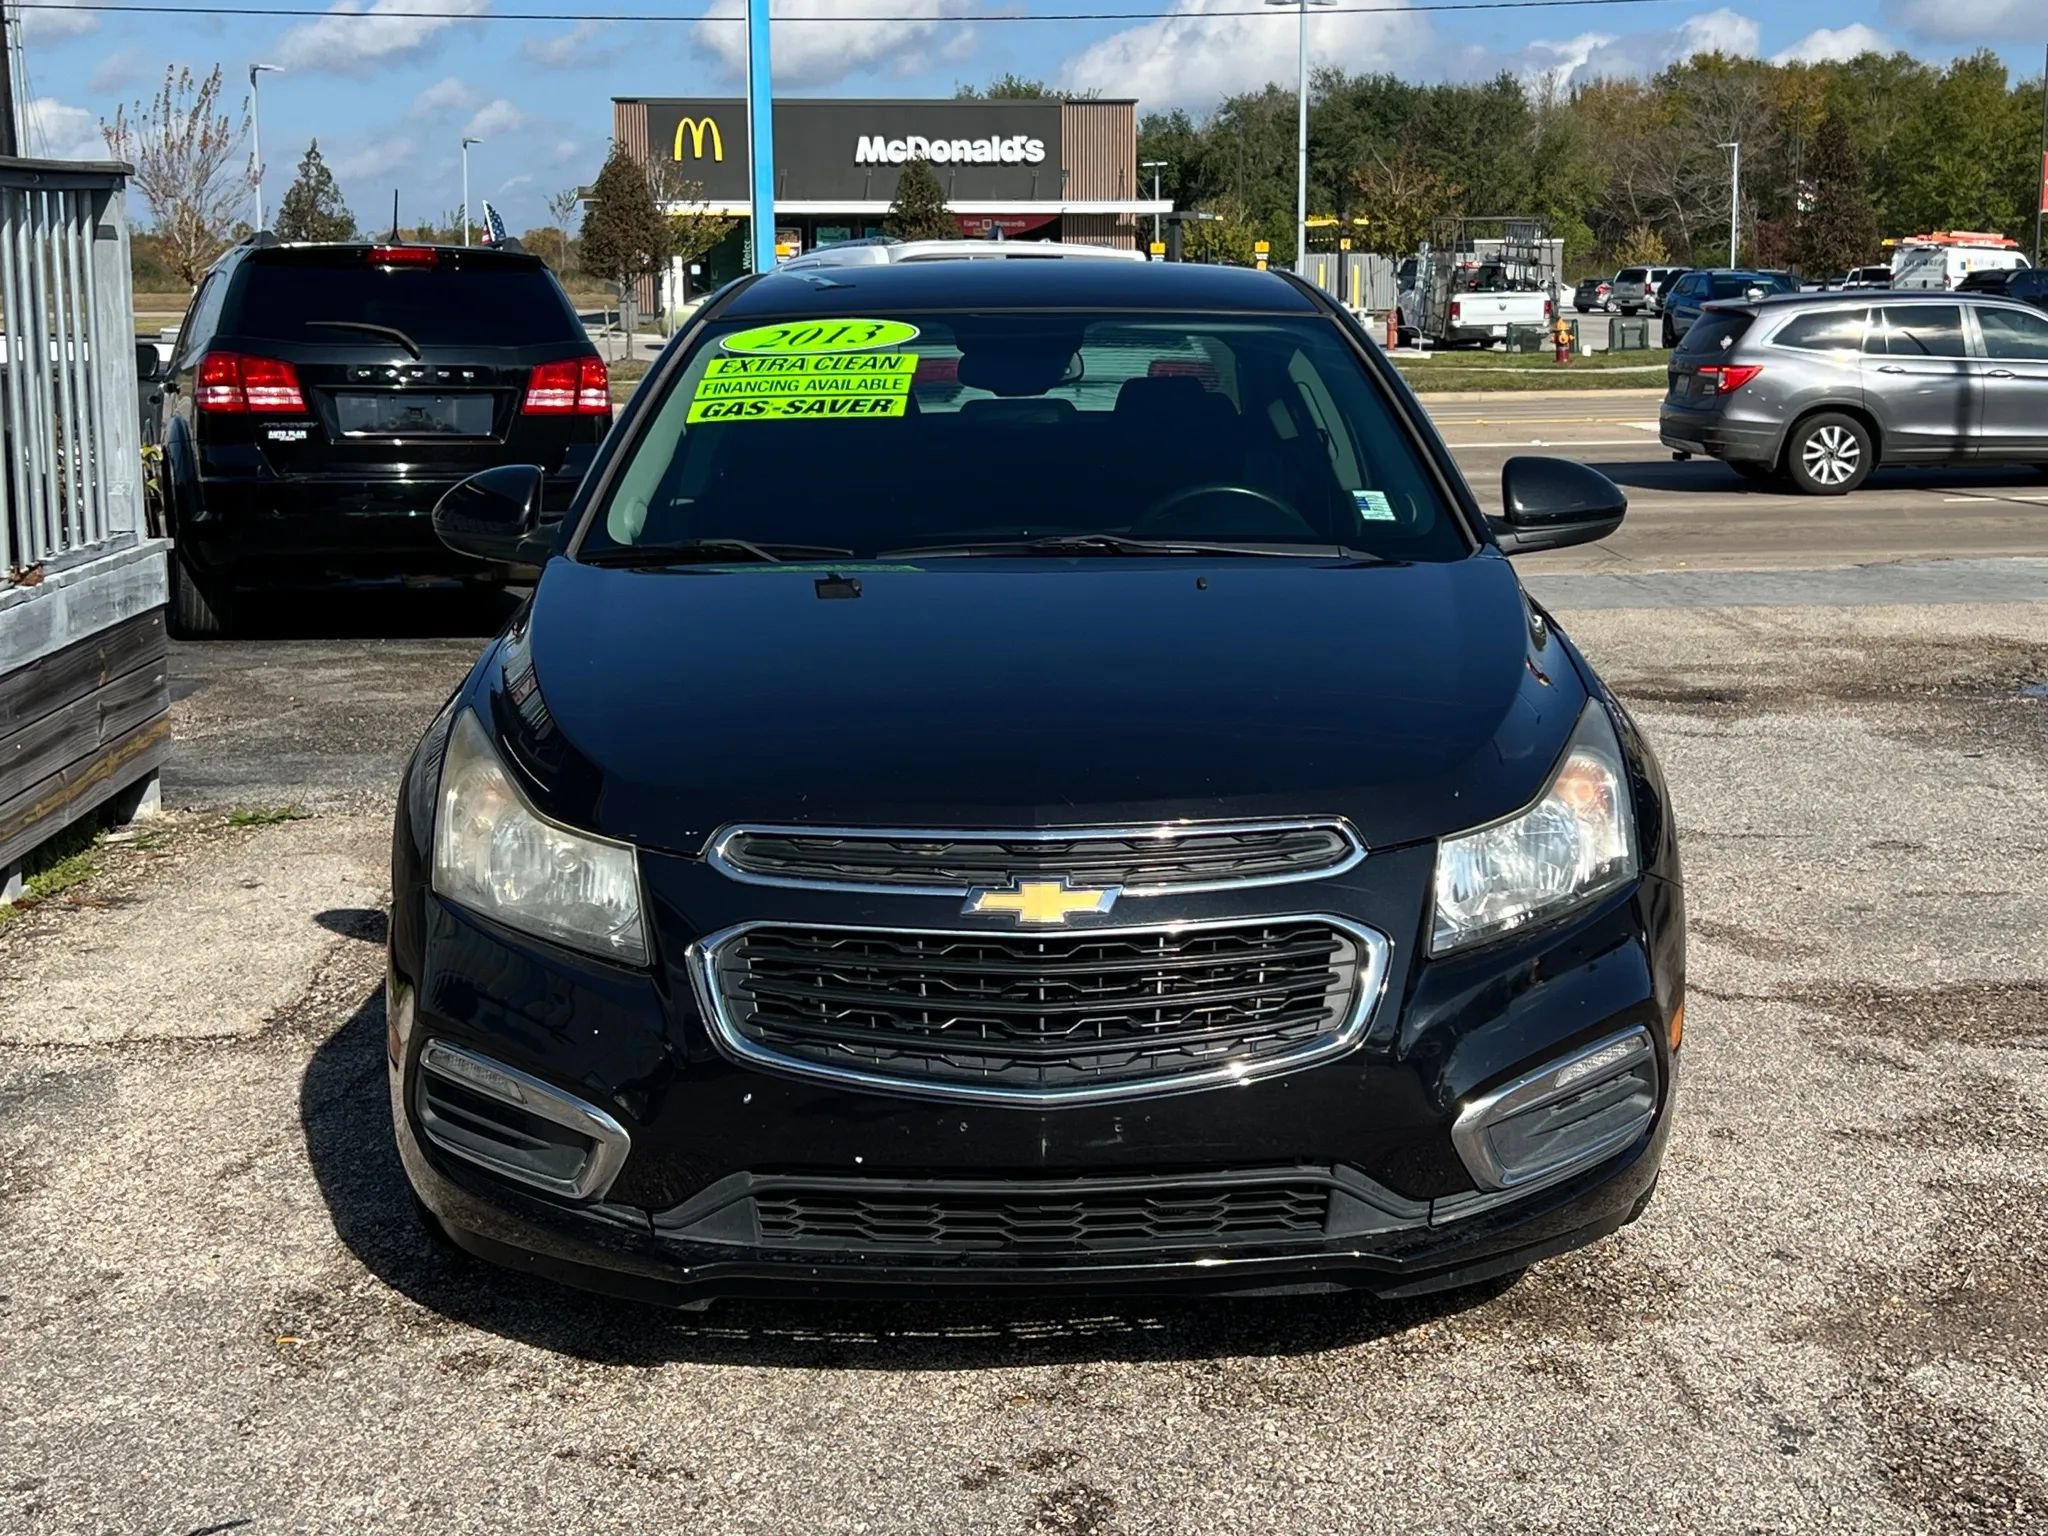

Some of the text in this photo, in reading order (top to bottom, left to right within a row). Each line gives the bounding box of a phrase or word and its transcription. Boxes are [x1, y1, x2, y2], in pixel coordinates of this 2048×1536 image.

[855, 136, 1045, 163] McDonald's
[751, 324, 885, 349] 2013
[717, 356, 903, 374] EXTRA CLEAN
[703, 378, 904, 396] FINANCING AVAILABLE
[700, 399, 897, 418] GAS-SAVER
